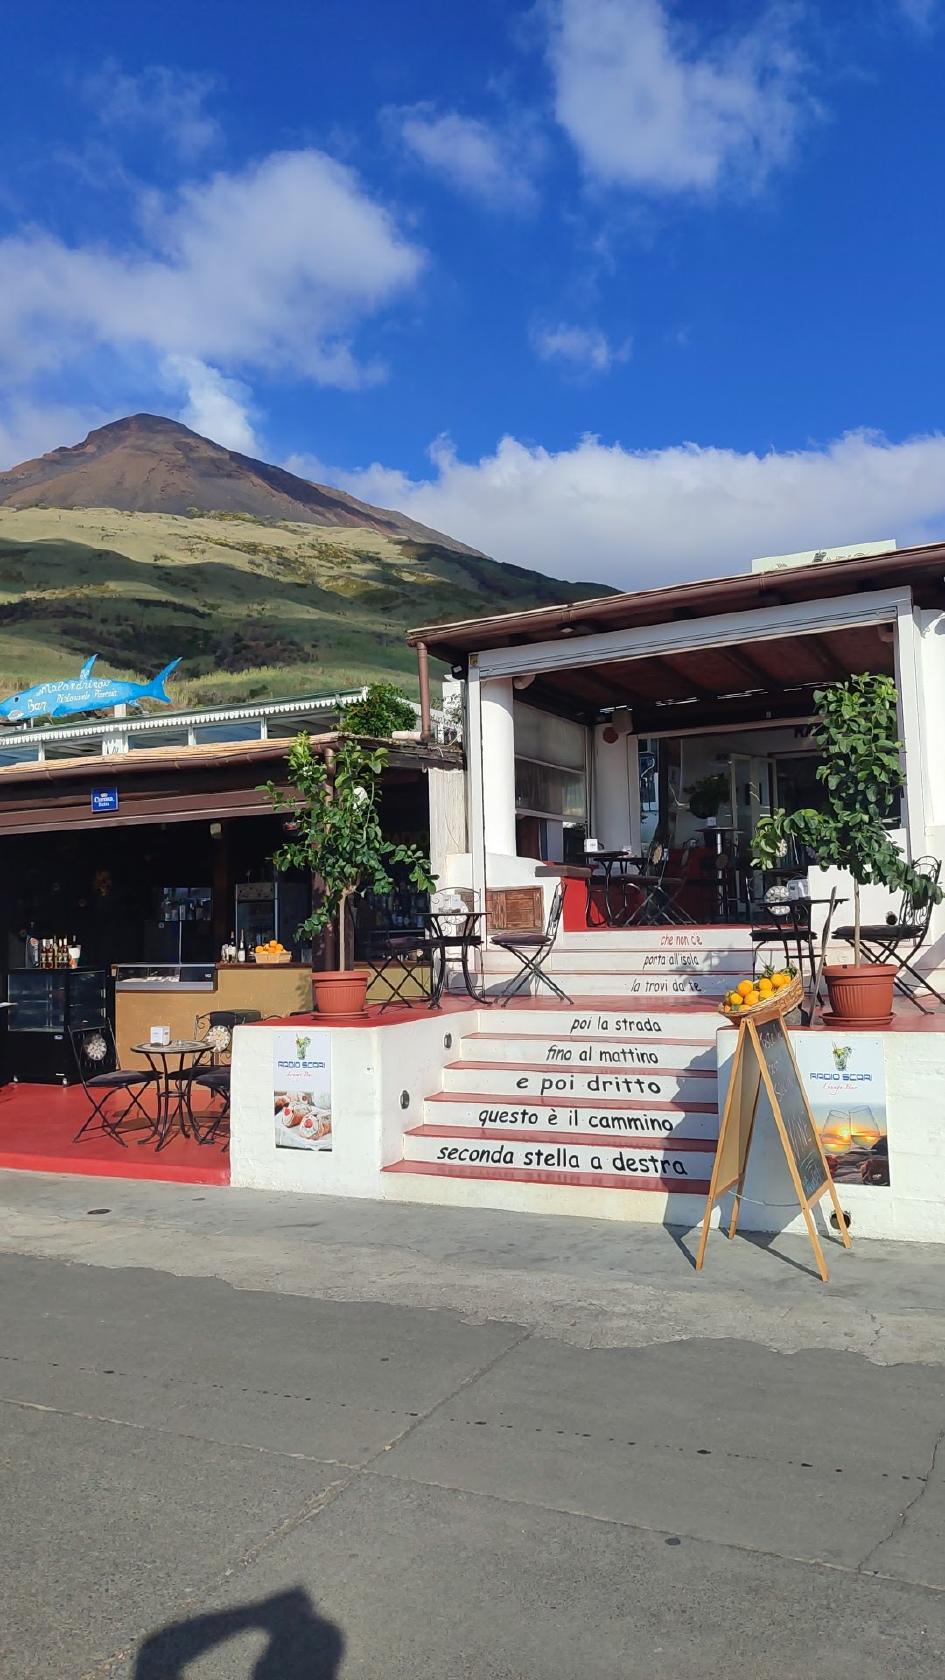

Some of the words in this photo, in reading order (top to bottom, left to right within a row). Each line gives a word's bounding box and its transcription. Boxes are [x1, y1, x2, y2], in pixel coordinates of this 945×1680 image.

[27, 699, 48, 712] Bar
[660, 933, 674, 946] che
[675, 935, 690, 946] non
[643, 953, 666, 970] porta
[631, 978, 641, 992] la
[645, 979, 668, 992] trovi
[672, 980, 686, 992] da
[688, 980, 702, 992] te
[570, 1016, 593, 1034] poi
[597, 1015, 609, 1031] la
[615, 1018, 662, 1032] strada
[546, 1044, 572, 1061] fino
[579, 1045, 592, 1061] al
[600, 1047, 659, 1064] mattino
[516, 1077, 529, 1089] e
[540, 1074, 575, 1096] poi
[587, 1074, 662, 1095] dritto
[478, 1108, 539, 1127] questo
[547, 1108, 559, 1126] è
[569, 1109, 578, 1127] il
[588, 1113, 675, 1132] cammino
[436, 1144, 514, 1165] seconda
[523, 1147, 580, 1169] stella
[590, 1155, 603, 1170] a
[612, 1151, 689, 1176] destra
